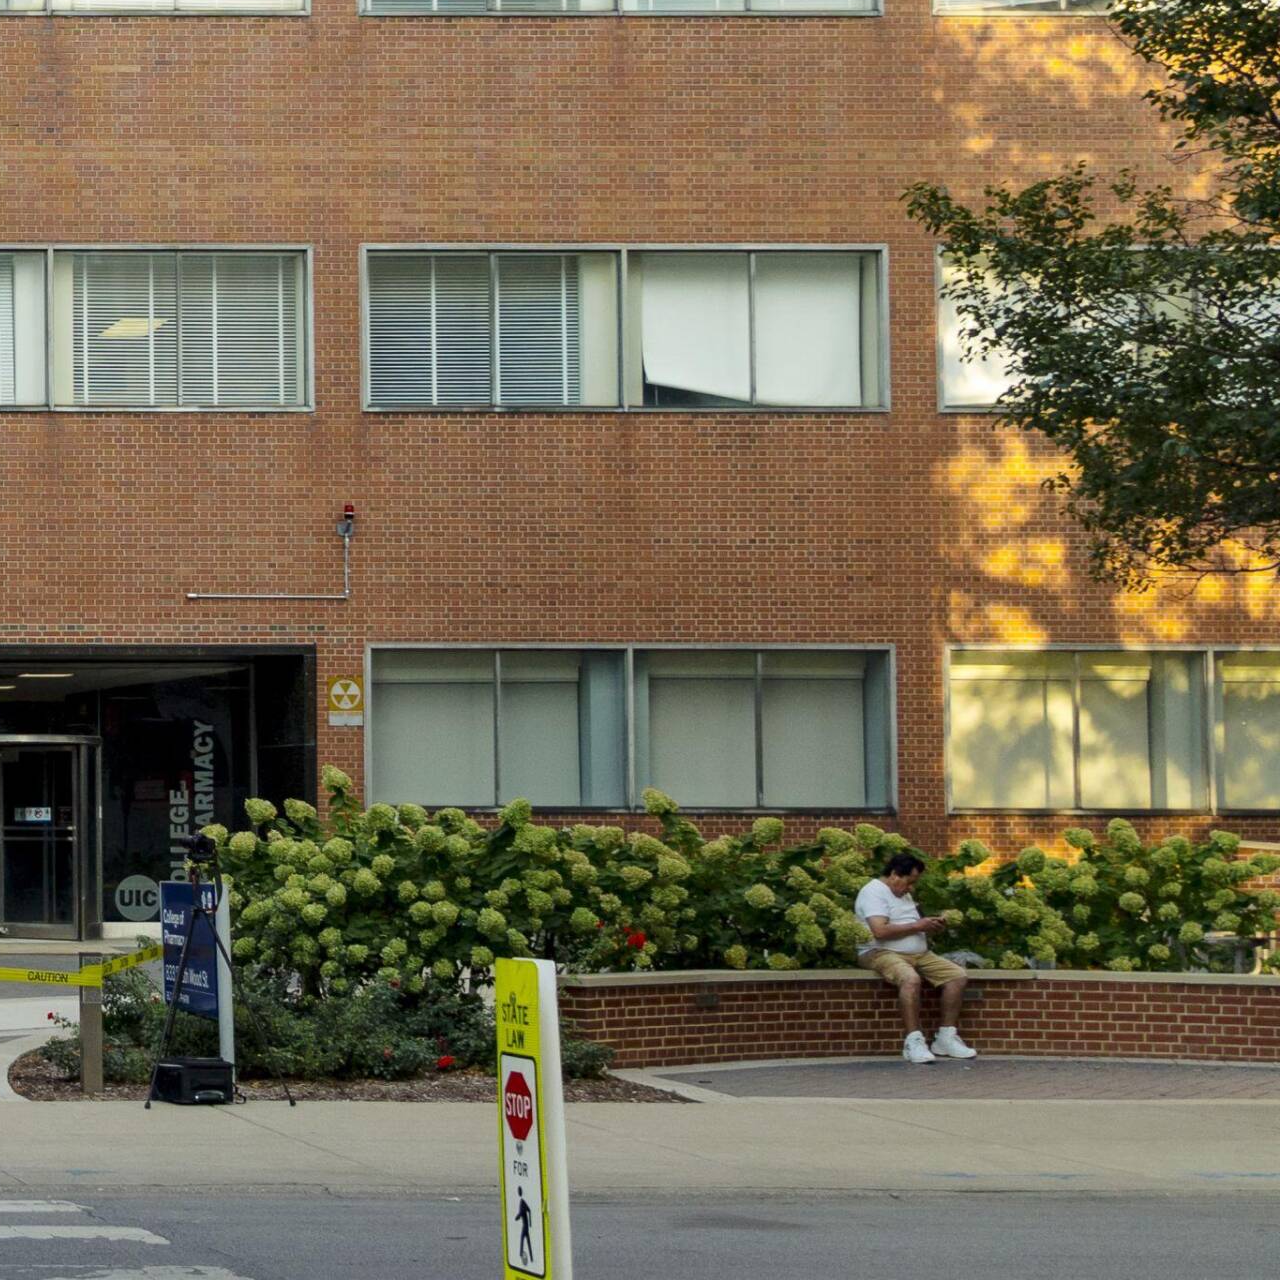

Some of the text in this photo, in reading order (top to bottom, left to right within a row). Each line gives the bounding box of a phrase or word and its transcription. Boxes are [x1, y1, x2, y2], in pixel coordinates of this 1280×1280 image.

[194, 720, 214, 828] ARMACY
[169, 789, 190, 881] OLLEGE
[119, 889, 158, 907] UIC
[27, 971, 68, 984] CAUTION
[502, 1002, 529, 1026] STATE
[506, 1029, 525, 1049] LAW
[506, 1092, 531, 1119] STOP
[513, 1160, 529, 1177] FOR
